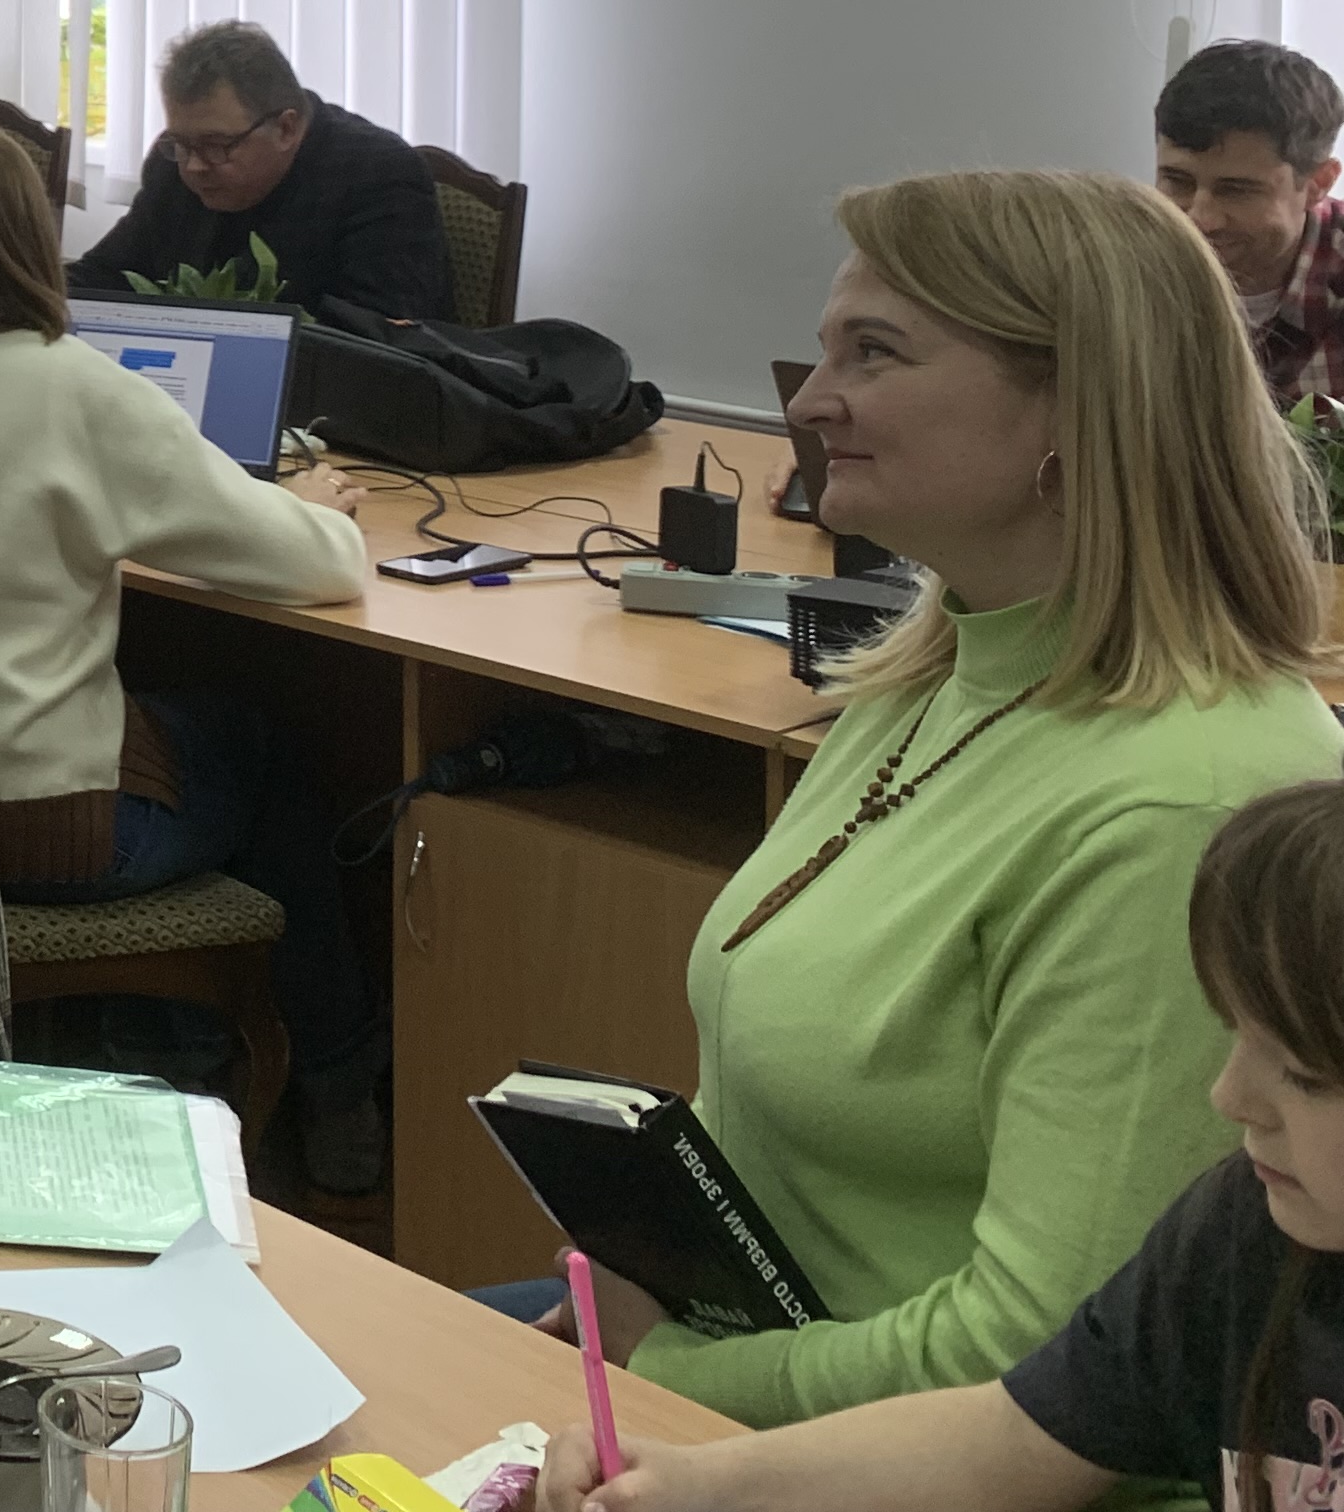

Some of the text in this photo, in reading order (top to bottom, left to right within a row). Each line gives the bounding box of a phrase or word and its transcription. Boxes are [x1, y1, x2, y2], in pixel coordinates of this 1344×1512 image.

[673, 1132, 723, 1201] ЗРОБИ.
[716, 1199, 730, 1212] І
[723, 1209, 778, 1283] ВІЗЬМИ
